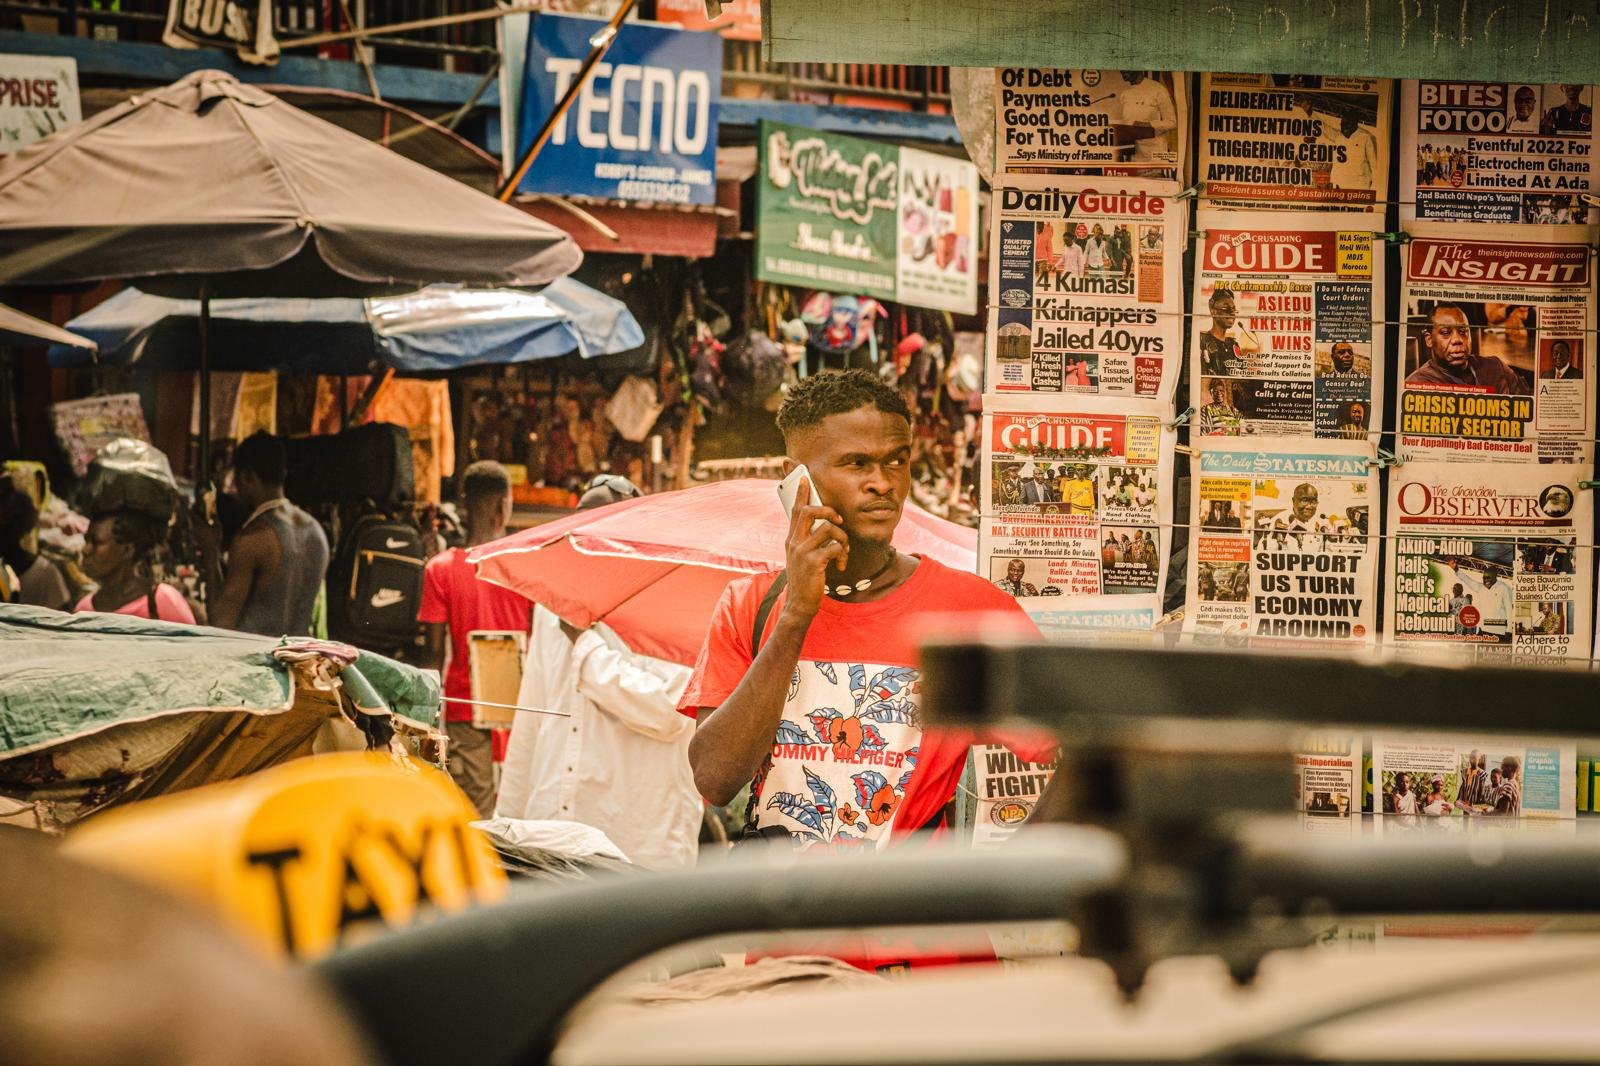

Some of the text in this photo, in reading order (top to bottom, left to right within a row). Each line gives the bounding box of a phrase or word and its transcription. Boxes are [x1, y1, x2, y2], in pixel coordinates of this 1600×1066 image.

[1002, 69, 1072, 87] Of Debt
[1003, 90, 1090, 110] Payments
[1210, 91, 1294, 110] DELIBERATE
[1421, 84, 1502, 106] BITES
[545, 57, 711, 155] TECNO
[1004, 110, 1108, 127] Good Omen
[1208, 115, 1322, 137] INTERVENTIONS
[1420, 110, 1505, 132] FOTOO
[1006, 128, 1114, 146] For The Cedi
[1208, 139, 1348, 163] TRIGGERING CEDI'S
[1467, 138, 1590, 155] Eventful 2022 For
[1038, 150, 1112, 161] Ministry of Finance
[1467, 156, 1590, 172] Electrochem Ghana
[1207, 164, 1311, 186] APPRECIATION
[1466, 173, 1589, 190] Limited At Ada
[1212, 185, 1249, 194] President
[1252, 188, 1285, 196] assures
[1299, 190, 1345, 199] sustaining
[1467, 193, 1494, 201] Napo's
[1424, 210, 1511, 219] Beneficiaries Graduate
[1234, 234, 1248, 245] NEW
[1211, 242, 1323, 270] GUIDE
[1439, 244, 1472, 259] The
[1478, 249, 1583, 259] theinsightnewsonline.com
[1420, 245, 1583, 281] INSIGHT
[1035, 271, 1050, 291] 4
[1055, 272, 1134, 294] Kumasi
[1231, 282, 1287, 293] Chairmanship
[1036, 298, 1156, 326] Kidnappers
[1258, 296, 1312, 312] ASIEDU
[1250, 316, 1312, 331] NKETIAH
[1033, 327, 1163, 355] Jailed 40yrs
[1272, 336, 1312, 351] WINS
[1034, 354, 1060, 362] 7 Killed
[1041, 362, 1061, 370] Fresh
[1032, 377, 1060, 386] Clashes
[1035, 370, 1059, 378] Bawku
[1099, 376, 1133, 384] Launched
[1136, 374, 1160, 382] Criticism
[1292, 391, 1312, 399] Calm
[1404, 395, 1455, 413] CRISIS
[1459, 398, 1509, 417] LOOMS
[1513, 400, 1530, 419] IN
[1404, 415, 1520, 437] ENERGY SECTOR
[1002, 424, 1113, 450] GUIDE
[1402, 437, 1532, 452] Over Appallingly Bad Genser Deal
[1201, 452, 1367, 473] The Daily STATESMAN
[1432, 485, 1447, 496] The
[1398, 482, 1541, 517] OBSERVER
[992, 526, 1098, 539] NAT. SECURITY BATTLE CRY
[1256, 553, 1361, 573] SUPPORT
[1398, 556, 1428, 574] Hails
[1047, 577, 1068, 585] Queen
[1261, 575, 1354, 594] US TURN
[1397, 575, 1434, 594] Cedi's
[1517, 576, 1535, 584] Veep
[1082, 586, 1098, 594] Fight
[1255, 596, 1362, 617] ECONOMY
[1397, 594, 1449, 614] Magical
[1257, 619, 1351, 638] AROUND
[1397, 612, 1455, 631] Rebound
[1517, 635, 1569, 644] Adhere to
[1516, 646, 1567, 654] COVID-19
[771, 743, 828, 761] OMMY
[986, 752, 1030, 774] WIN
[986, 774, 1046, 798] FIGHT
[1000, 809, 1025, 819] NPA
